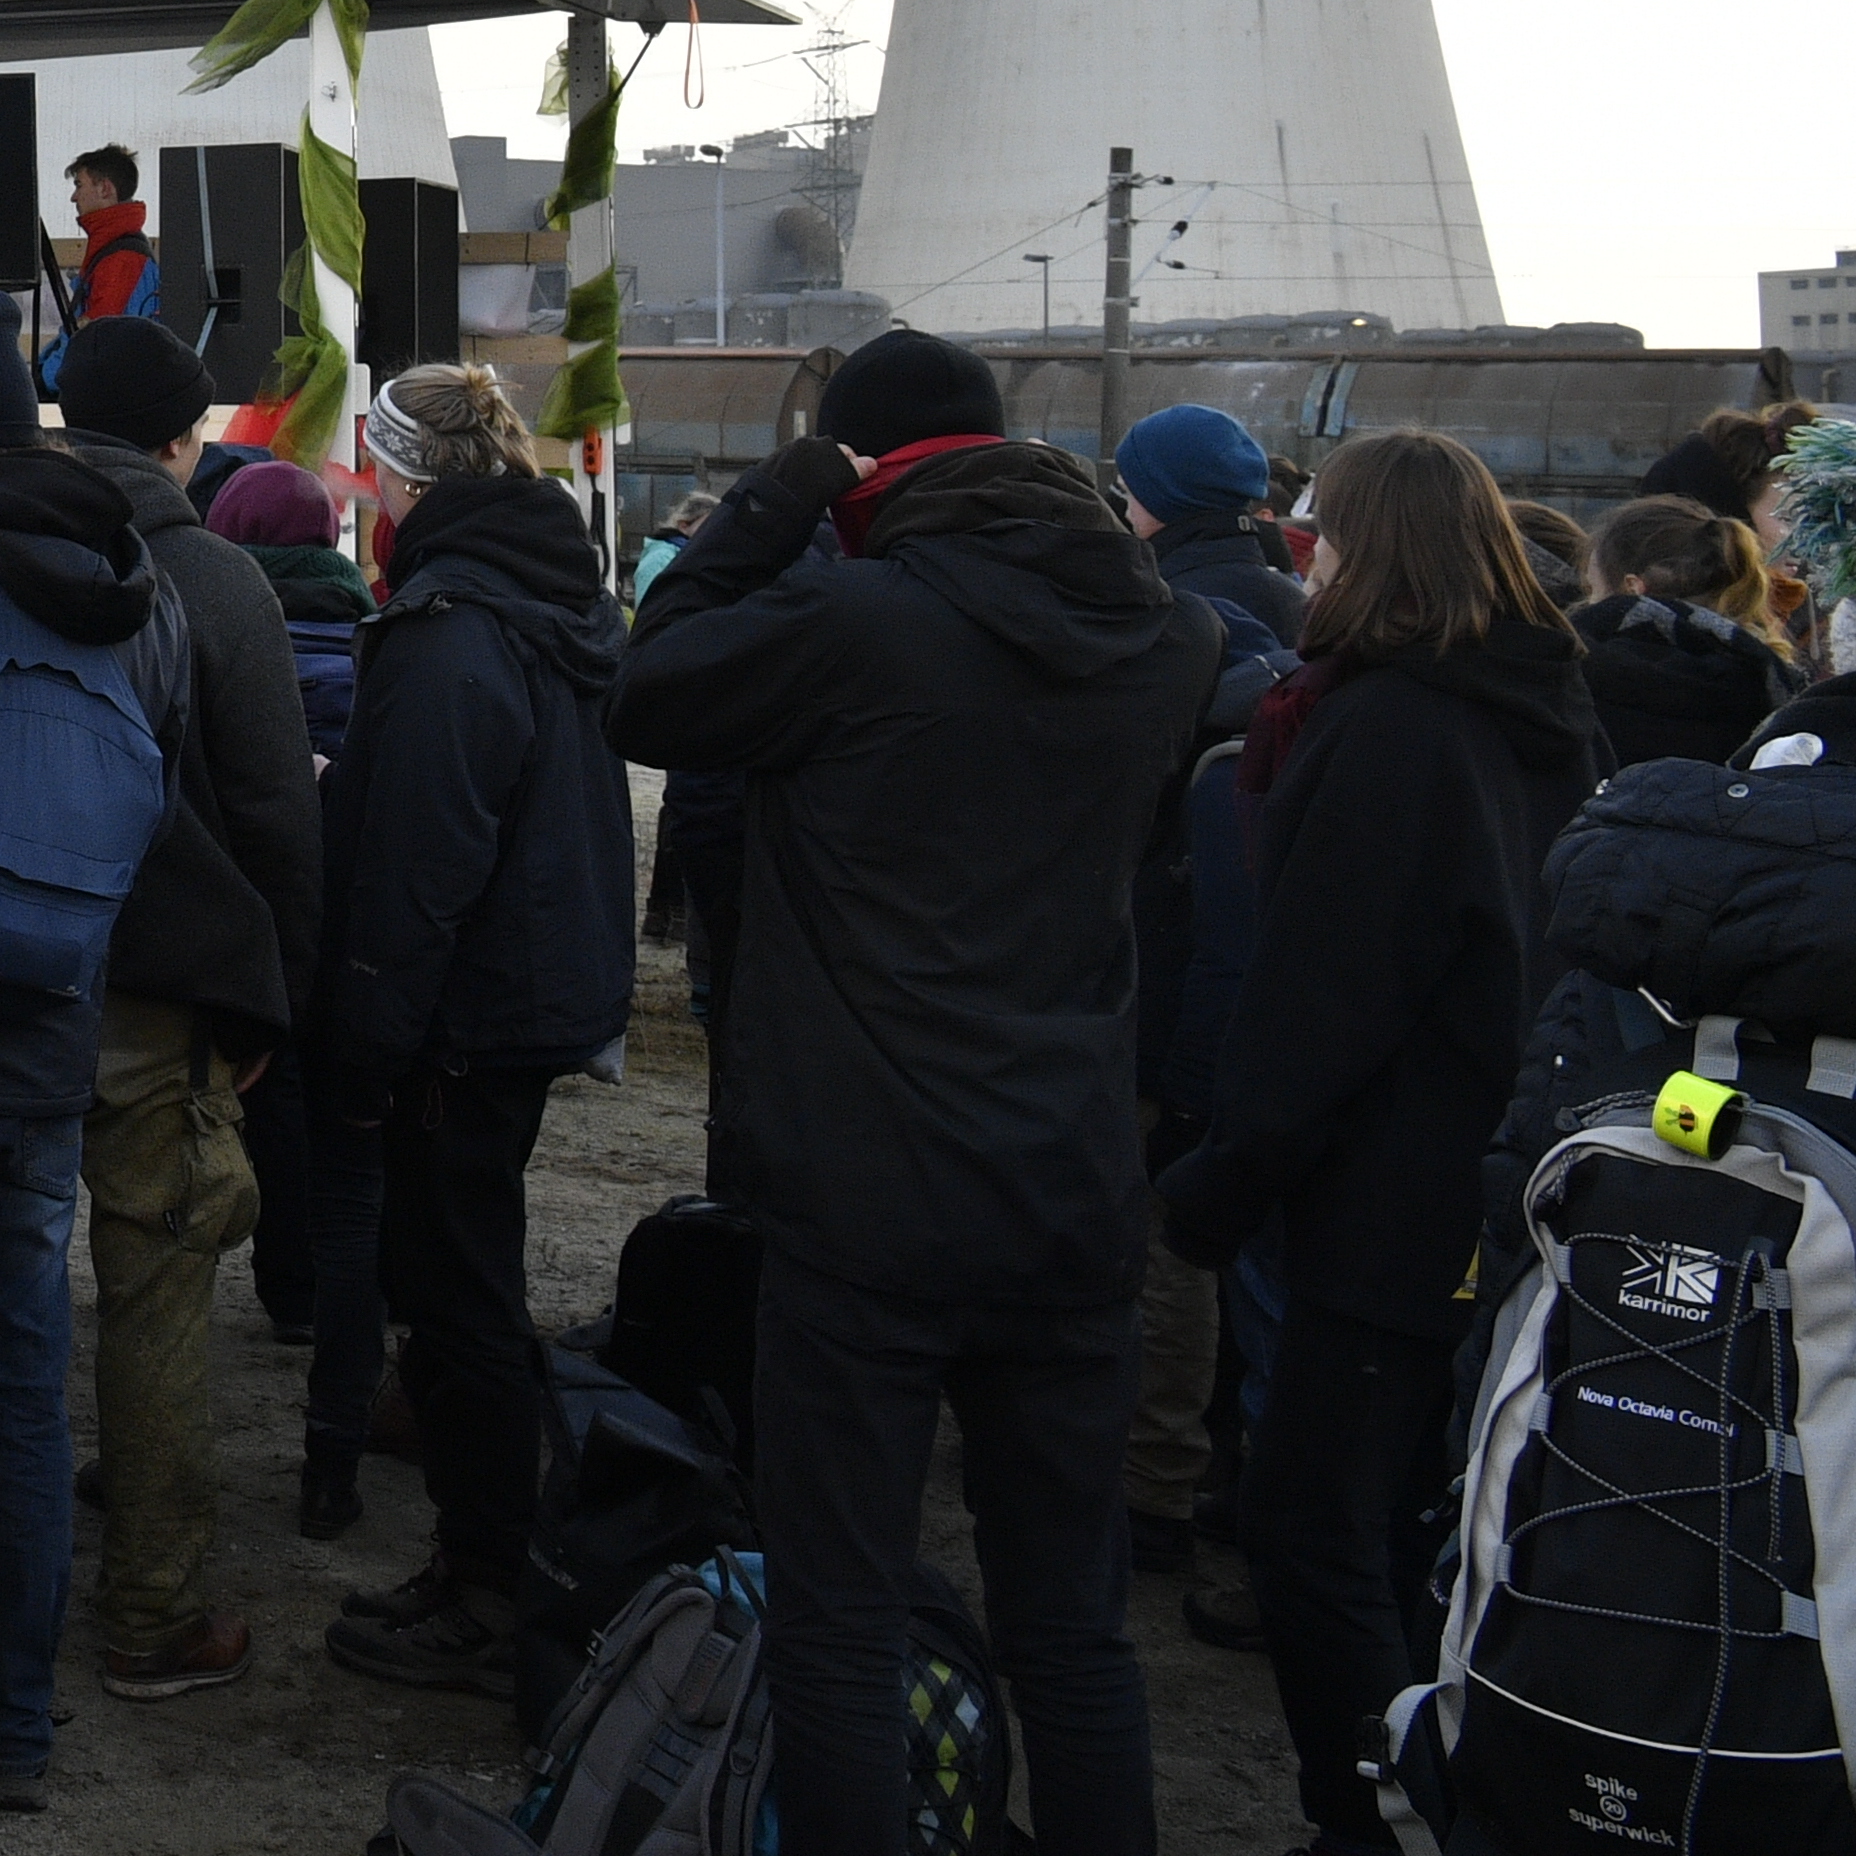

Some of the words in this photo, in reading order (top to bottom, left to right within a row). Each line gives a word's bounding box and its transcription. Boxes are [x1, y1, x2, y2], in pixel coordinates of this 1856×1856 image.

[1618, 1288, 1711, 1322] karrimor
[1577, 1385, 1614, 1408] Nova
[1618, 1396, 1675, 1422] Octavia
[1584, 1773, 1638, 1801] spike
[1604, 1800, 1622, 1816] 20
[1568, 1807, 1676, 1847] superwick
